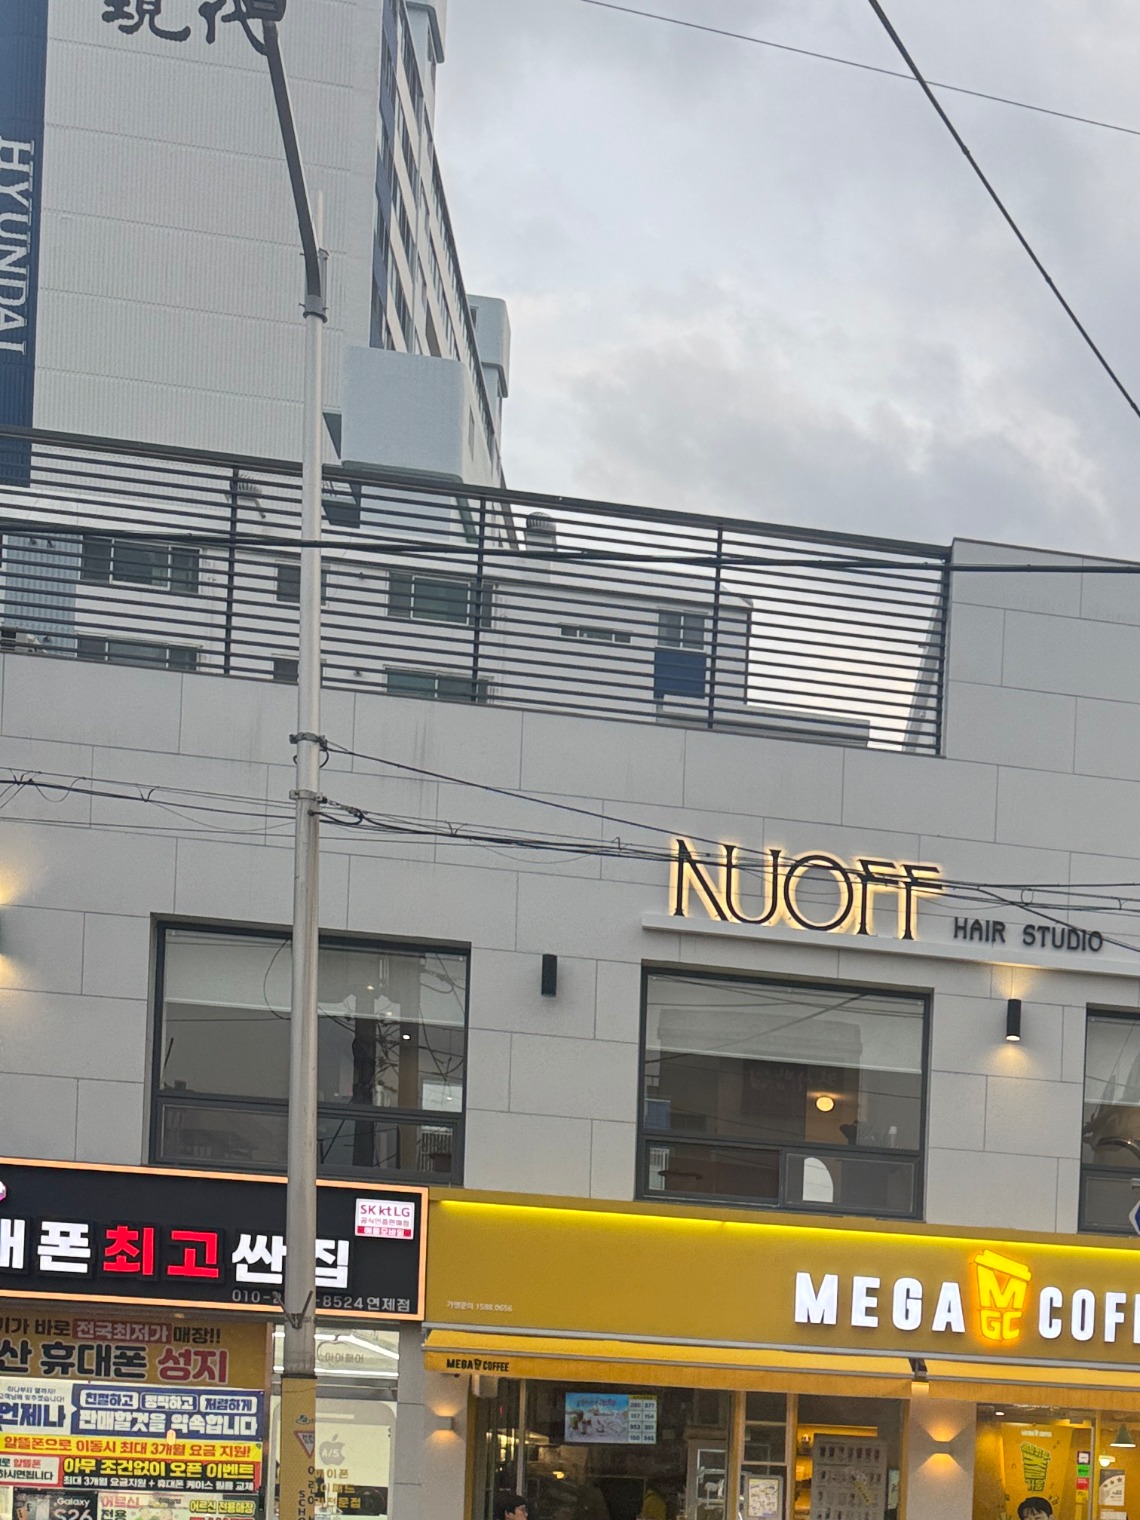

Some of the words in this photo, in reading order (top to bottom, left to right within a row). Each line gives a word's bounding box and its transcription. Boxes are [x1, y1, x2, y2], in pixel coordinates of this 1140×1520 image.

[672, 838, 944, 940] NUOFF
[953, 917, 1006, 944] HAIR
[1022, 924, 1104, 952] STUDIO
[360, 1204, 376, 1215] SK
[379, 1205, 392, 1216] kt
[394, 1206, 410, 1218] LG
[103, 1224, 219, 1280] 최고
[366, 1296, 411, 1312] 연제점
[794, 1271, 966, 1334] MEGA
[35, 1318, 71, 1336] 바로
[76, 1320, 168, 1342] 전국최저가
[173, 1327, 221, 1345] 매장!!
[40, 1341, 147, 1380] 휴대폰
[157, 1347, 228, 1383] 성지
[446, 1358, 473, 1370] MEGA
[482, 1360, 510, 1372] COFFEE
[79, 1409, 167, 1433] 판매할것을
[170, 1413, 258, 1436] 약속합니다
[4, 1435, 72, 1451] 알뜰폰으로
[76, 1439, 116, 1453] 이동시
[120, 1441, 148, 1454] 최대
[151, 1443, 185, 1457] 3개월
[190, 1444, 216, 1457] 요금
[220, 1445, 251, 1458] 지원!
[63, 1457, 96, 1474] 아무
[100, 1459, 166, 1477] 조건없이
[169, 1461, 203, 1478] 오픈
[206, 1463, 254, 1479] 이벤트
[64, 1475, 82, 1485] 최대
[84, 1476, 107, 1486] 3개월
[186, 1480, 213, 1490] 케이스
[57, 1497, 91, 1508] Galaxy
[101, 1495, 140, 1508] 어르신
[190, 1499, 217, 1514] 어르신
